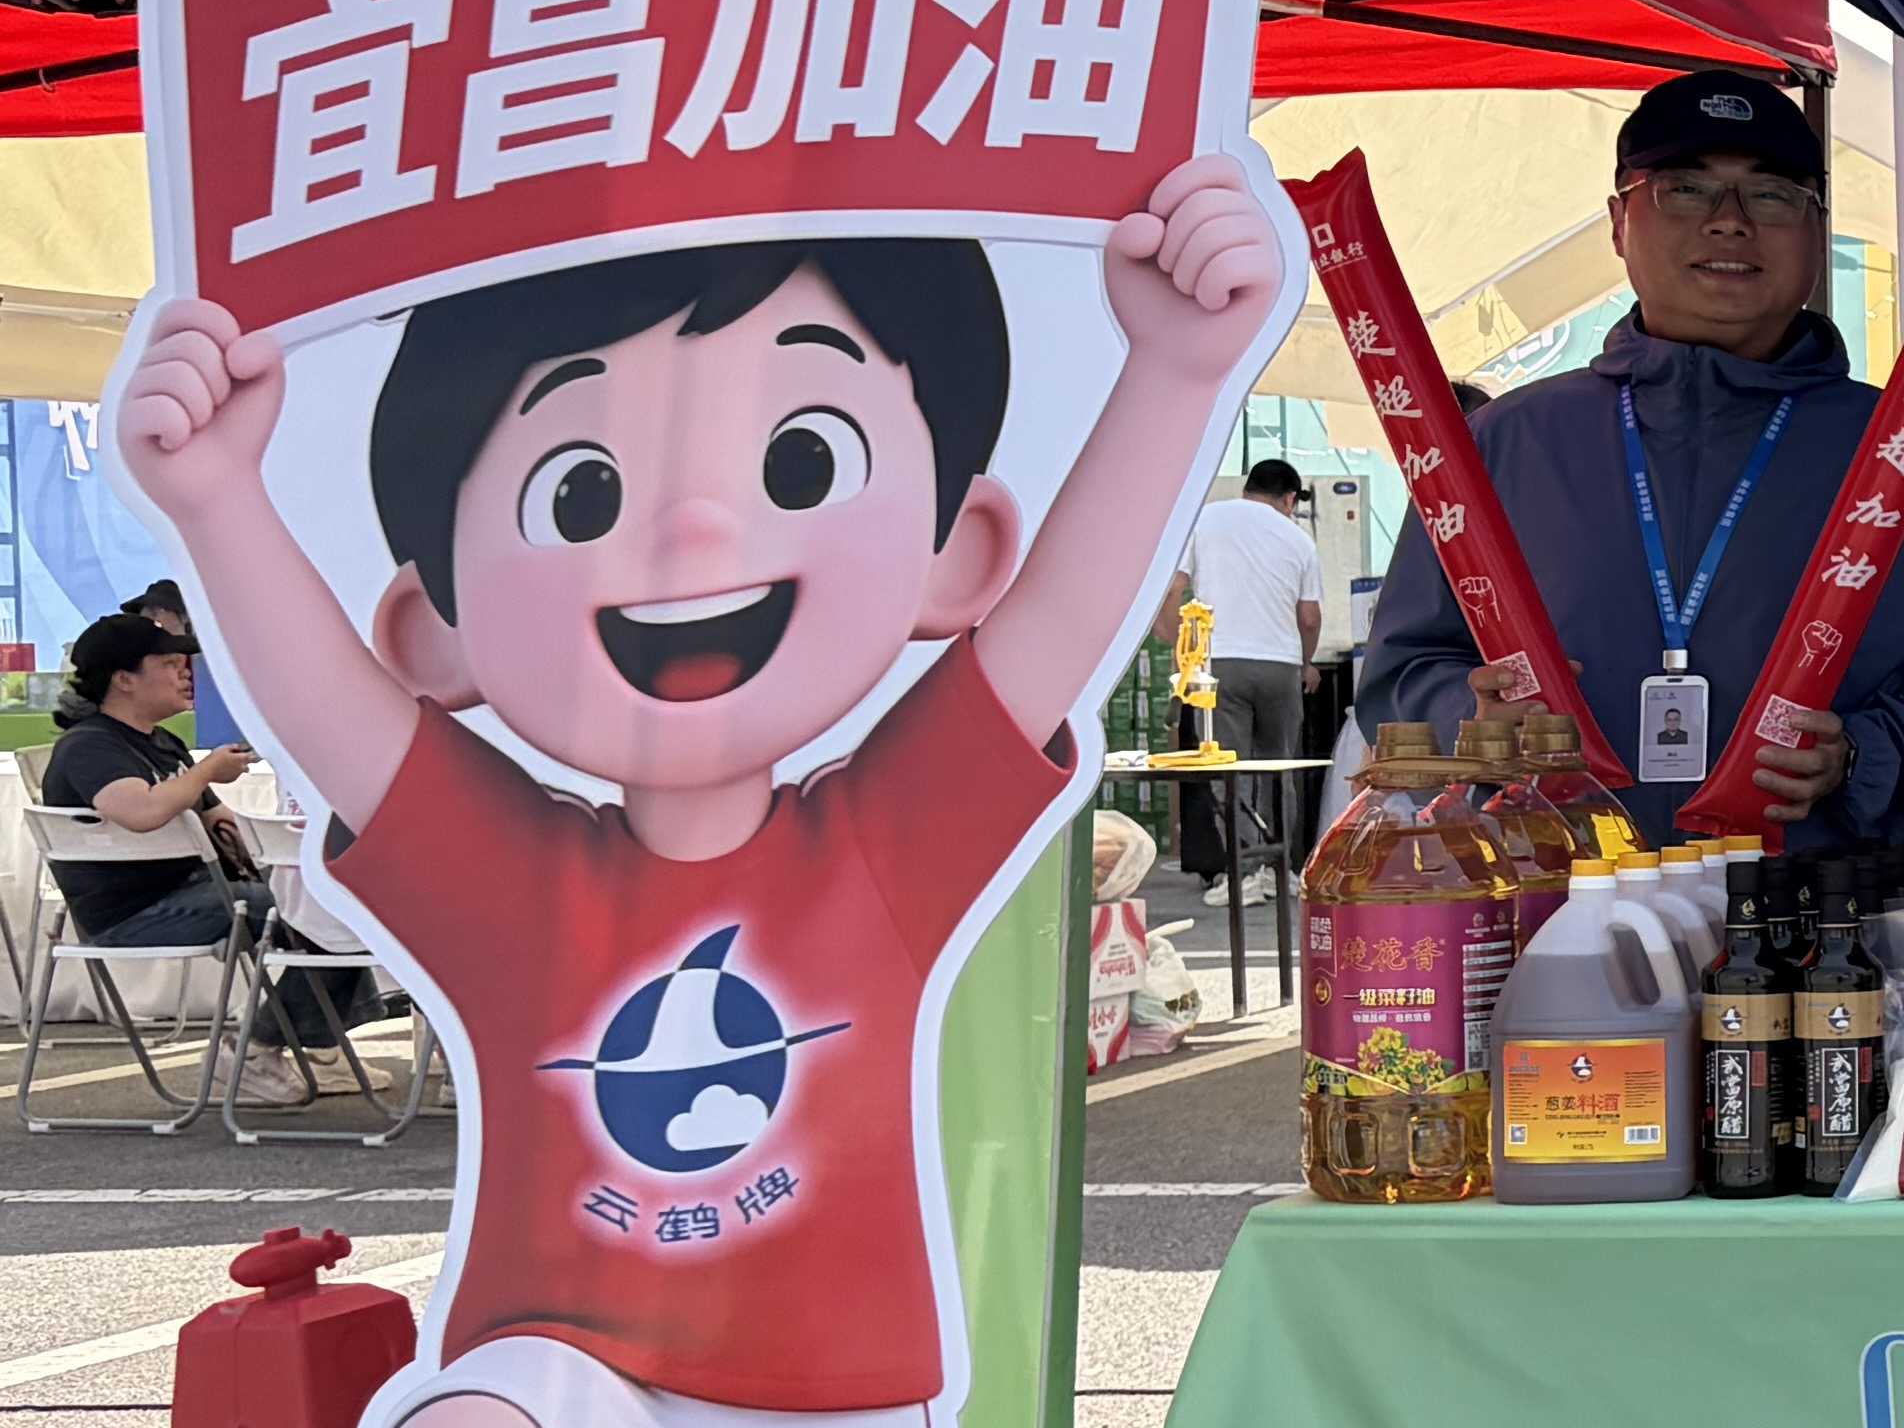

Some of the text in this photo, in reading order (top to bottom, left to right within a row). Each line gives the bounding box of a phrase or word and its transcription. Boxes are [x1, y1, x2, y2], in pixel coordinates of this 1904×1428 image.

[1314, 240, 1366, 271] 北银行
[1347, 309, 1467, 549] 楚超加油
[1341, 987, 1436, 1006] 一级菜籽油
[582, 1165, 803, 1246] 云鹤牌
